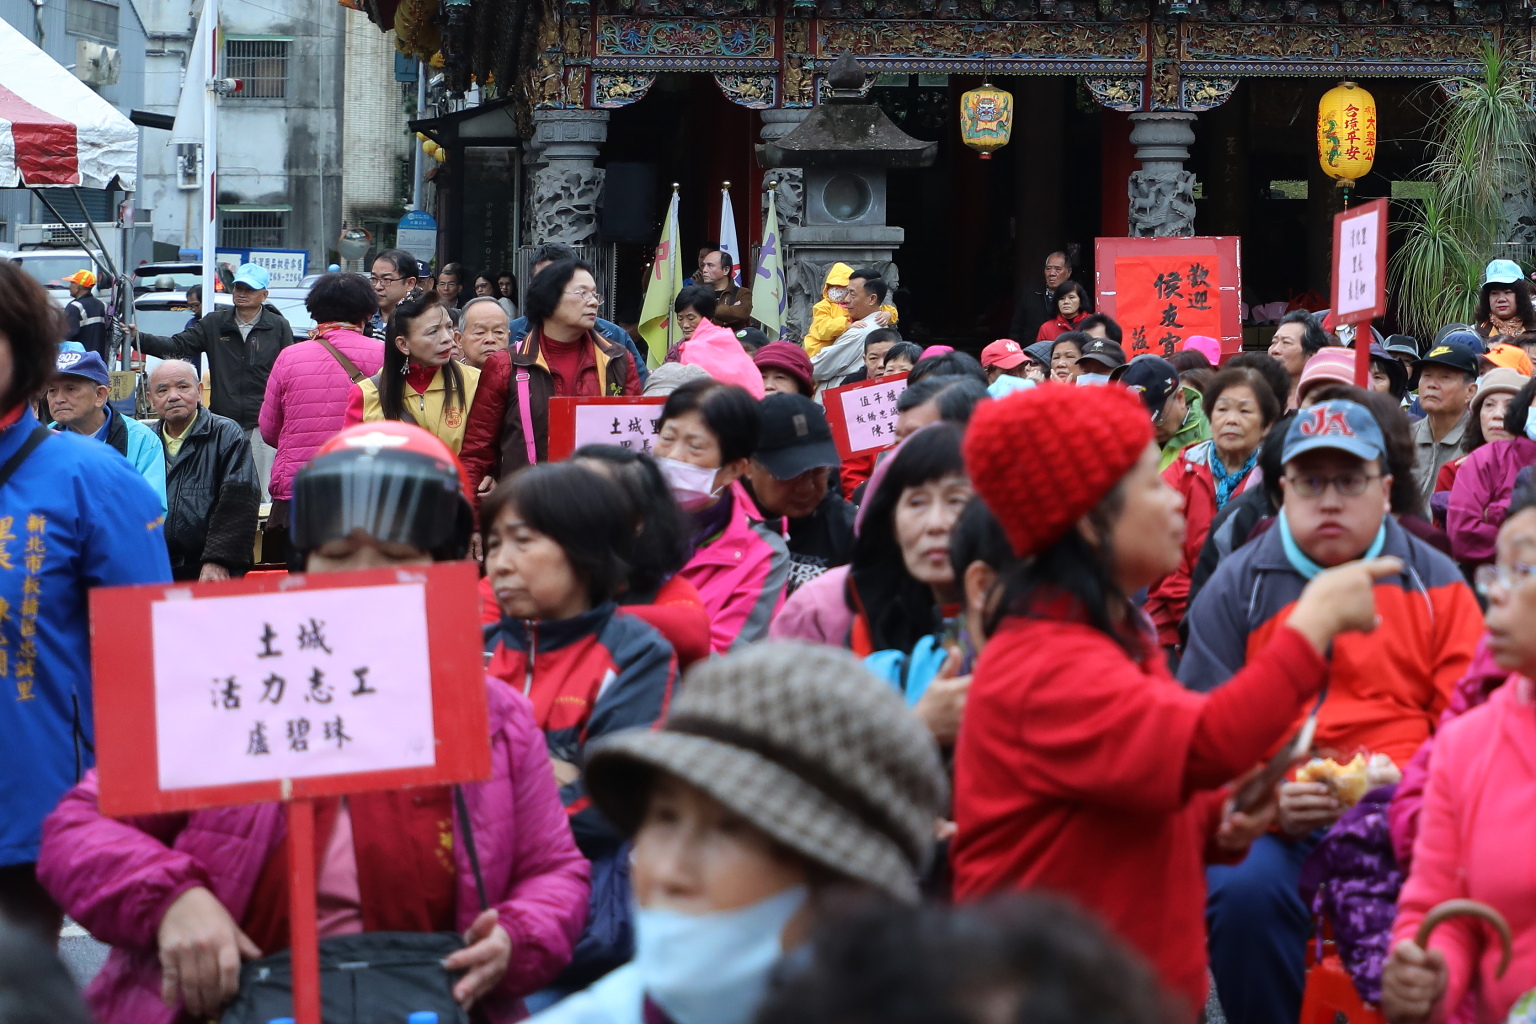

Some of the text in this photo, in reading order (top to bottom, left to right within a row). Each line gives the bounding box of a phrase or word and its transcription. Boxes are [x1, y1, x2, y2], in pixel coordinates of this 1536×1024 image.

[1344, 103, 1361, 161] 合境平安
[1186, 262, 1212, 311] 歡迎
[1153, 271, 1185, 359] 侯友宜
[859, 387, 906, 408] 值年爐
[610, 417, 660, 435] 土城里
[1300, 406, 1357, 437] JA
[257, 617, 333, 659] 土城
[210, 666, 377, 710] 活力志工
